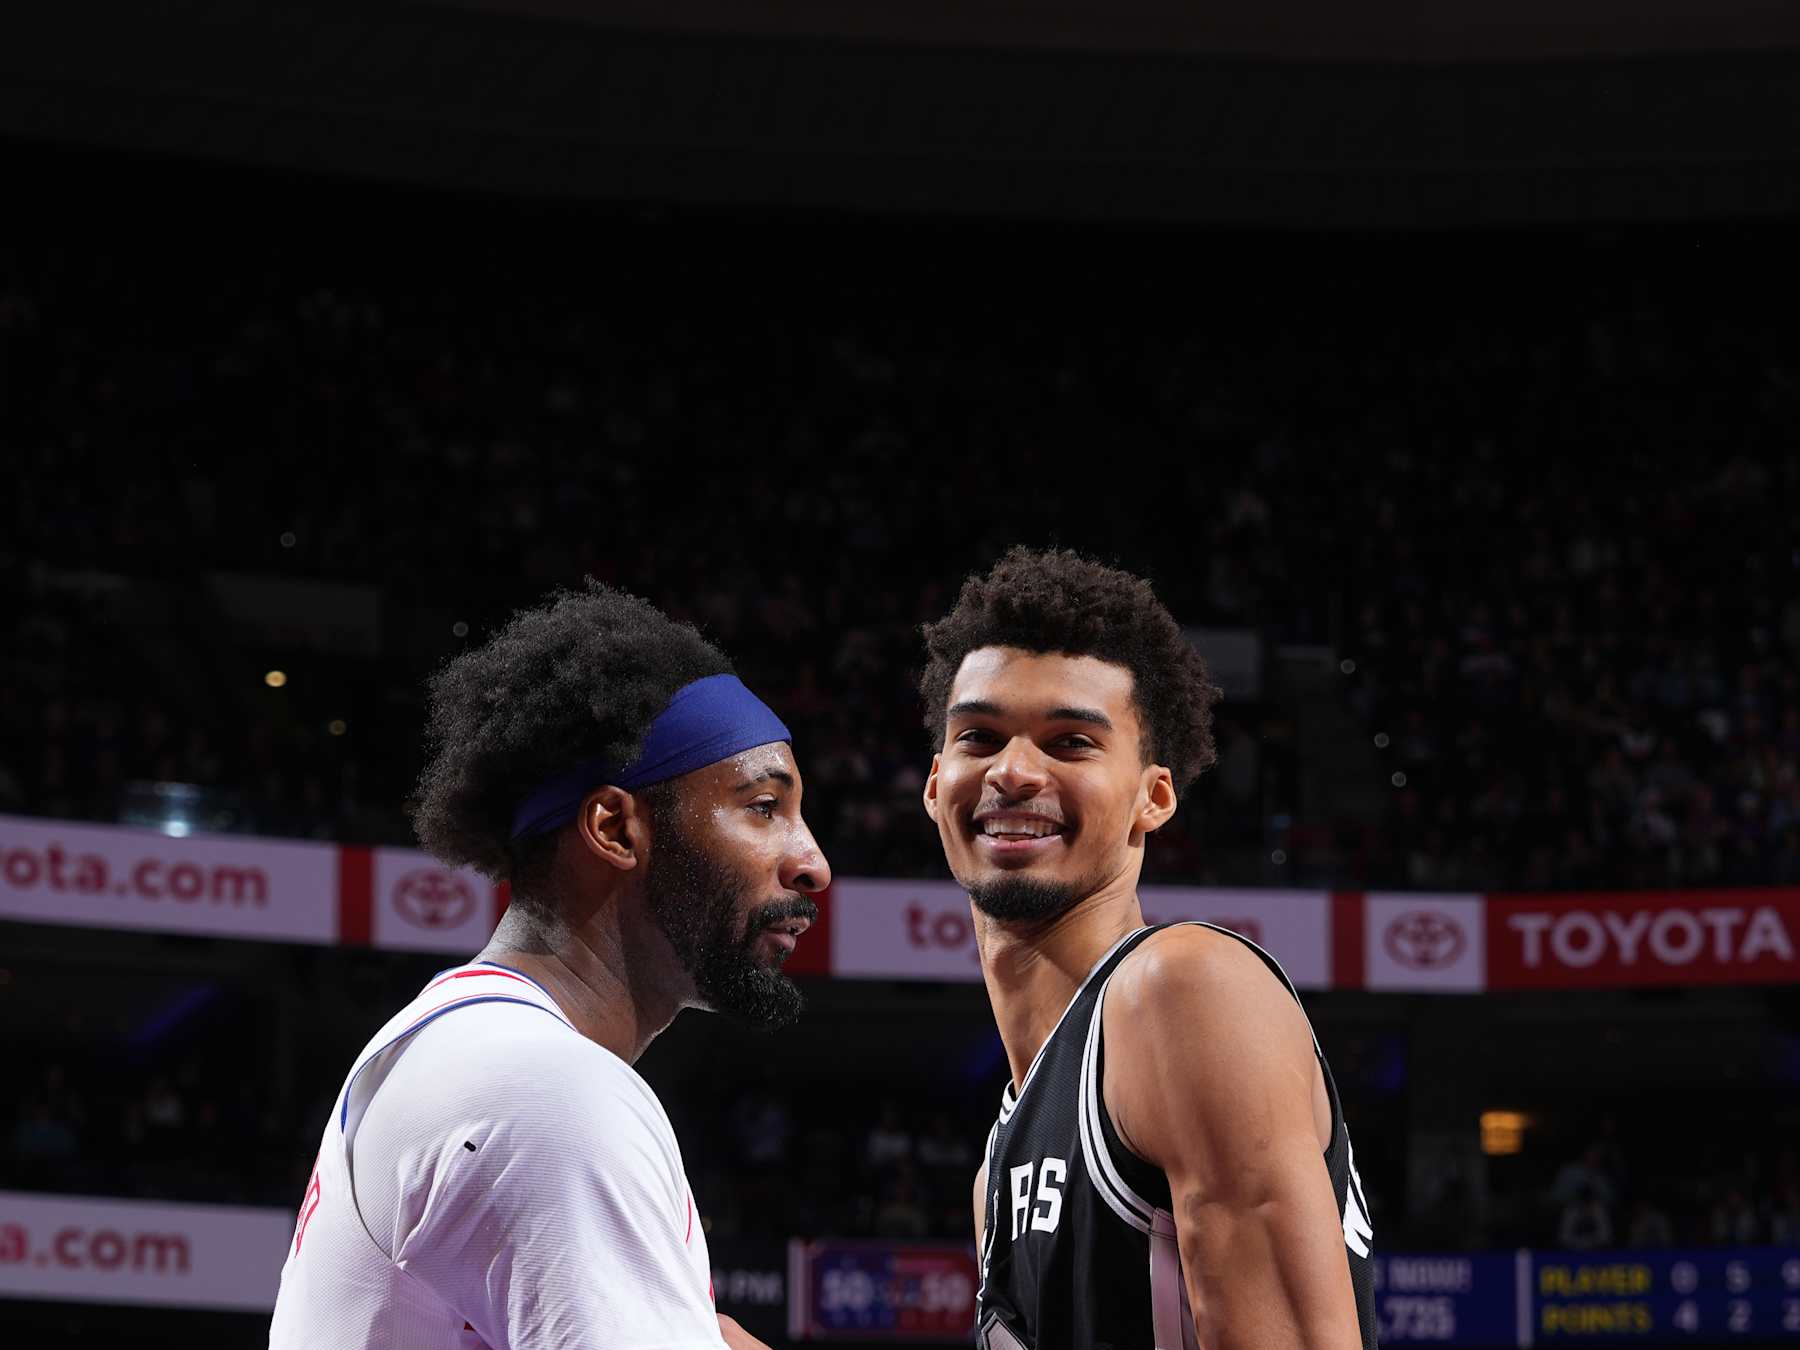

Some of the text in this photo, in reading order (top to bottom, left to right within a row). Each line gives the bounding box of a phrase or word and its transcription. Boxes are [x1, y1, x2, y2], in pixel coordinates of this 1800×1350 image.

[0, 844, 267, 907] ota.com
[905, 901, 979, 966] to
[1508, 906, 1792, 968] TOYOTA
[0, 1223, 191, 1275] a.com
[1540, 1264, 1652, 1296] PLAYER
[1541, 1301, 1653, 1335] POINTS
